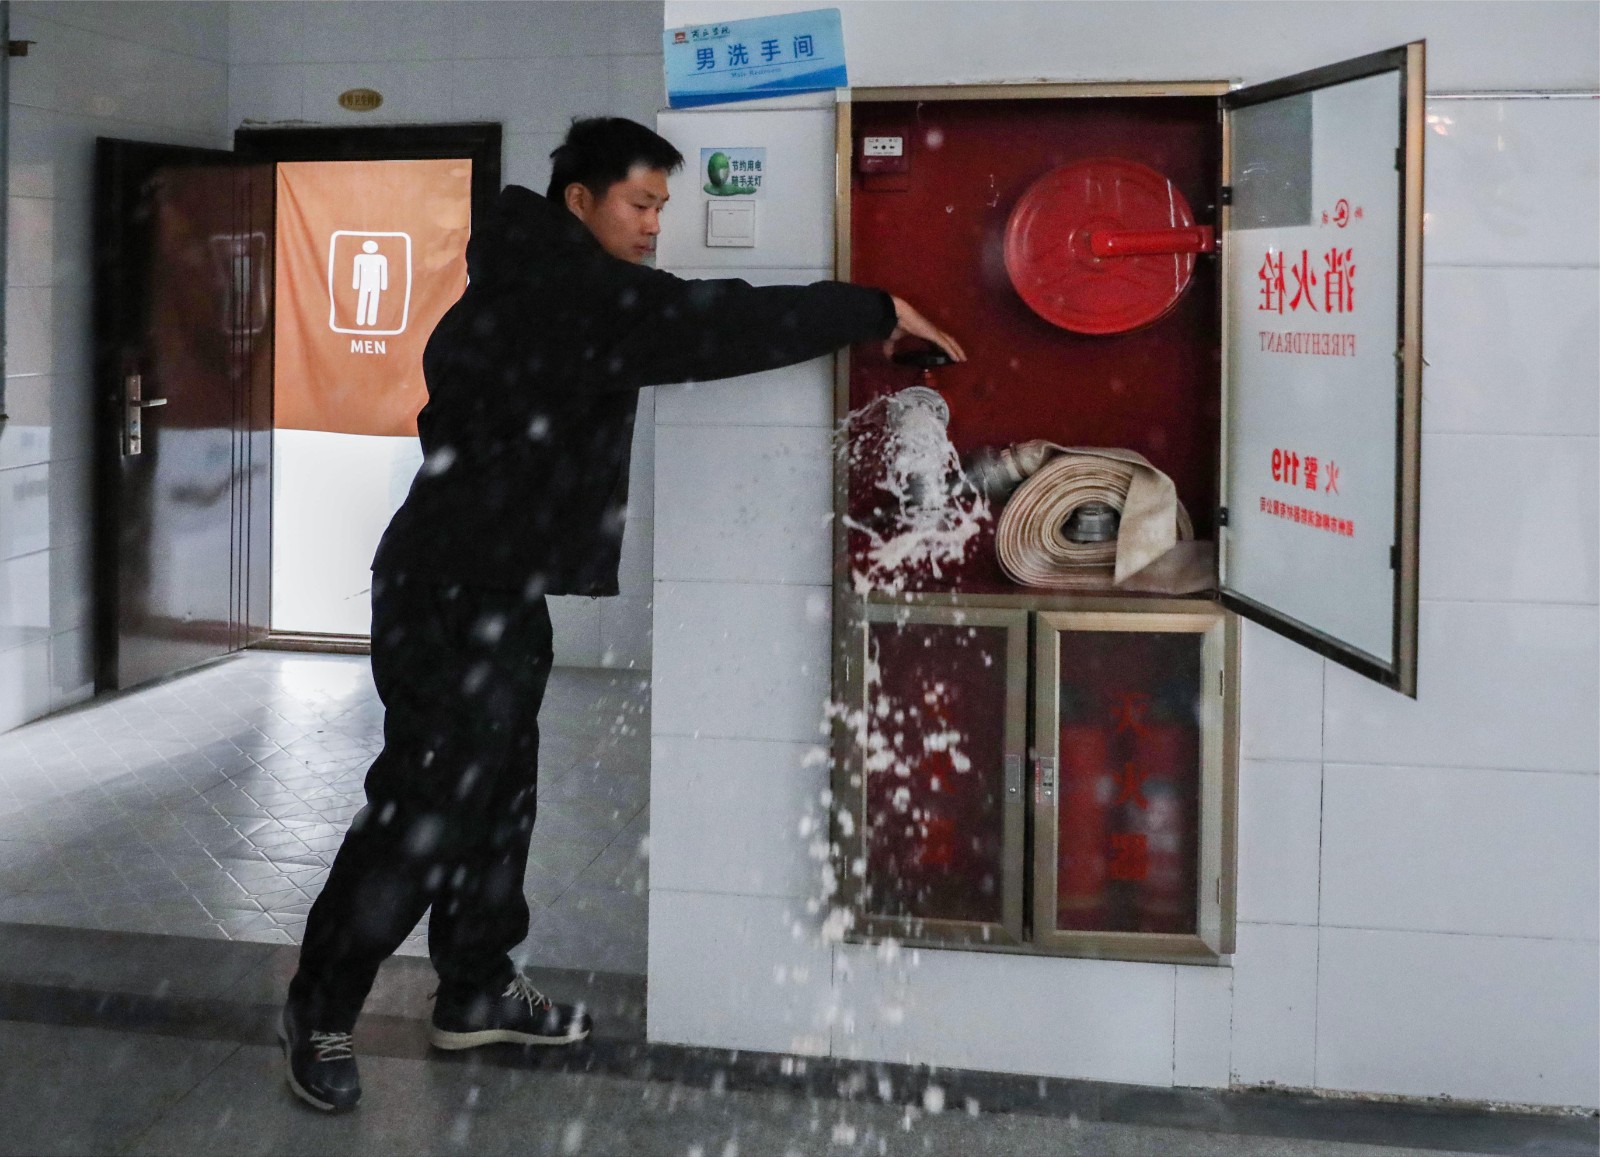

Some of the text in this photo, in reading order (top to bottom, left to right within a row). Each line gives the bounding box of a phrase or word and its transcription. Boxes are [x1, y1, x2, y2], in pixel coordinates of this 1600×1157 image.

[696, 34, 814, 71] 男洗手间
[731, 160, 763, 172] 节约用电
[731, 175, 763, 187] 随手关灯
[350, 339, 386, 355] MEN
[1109, 692, 1151, 880] 灭火器
